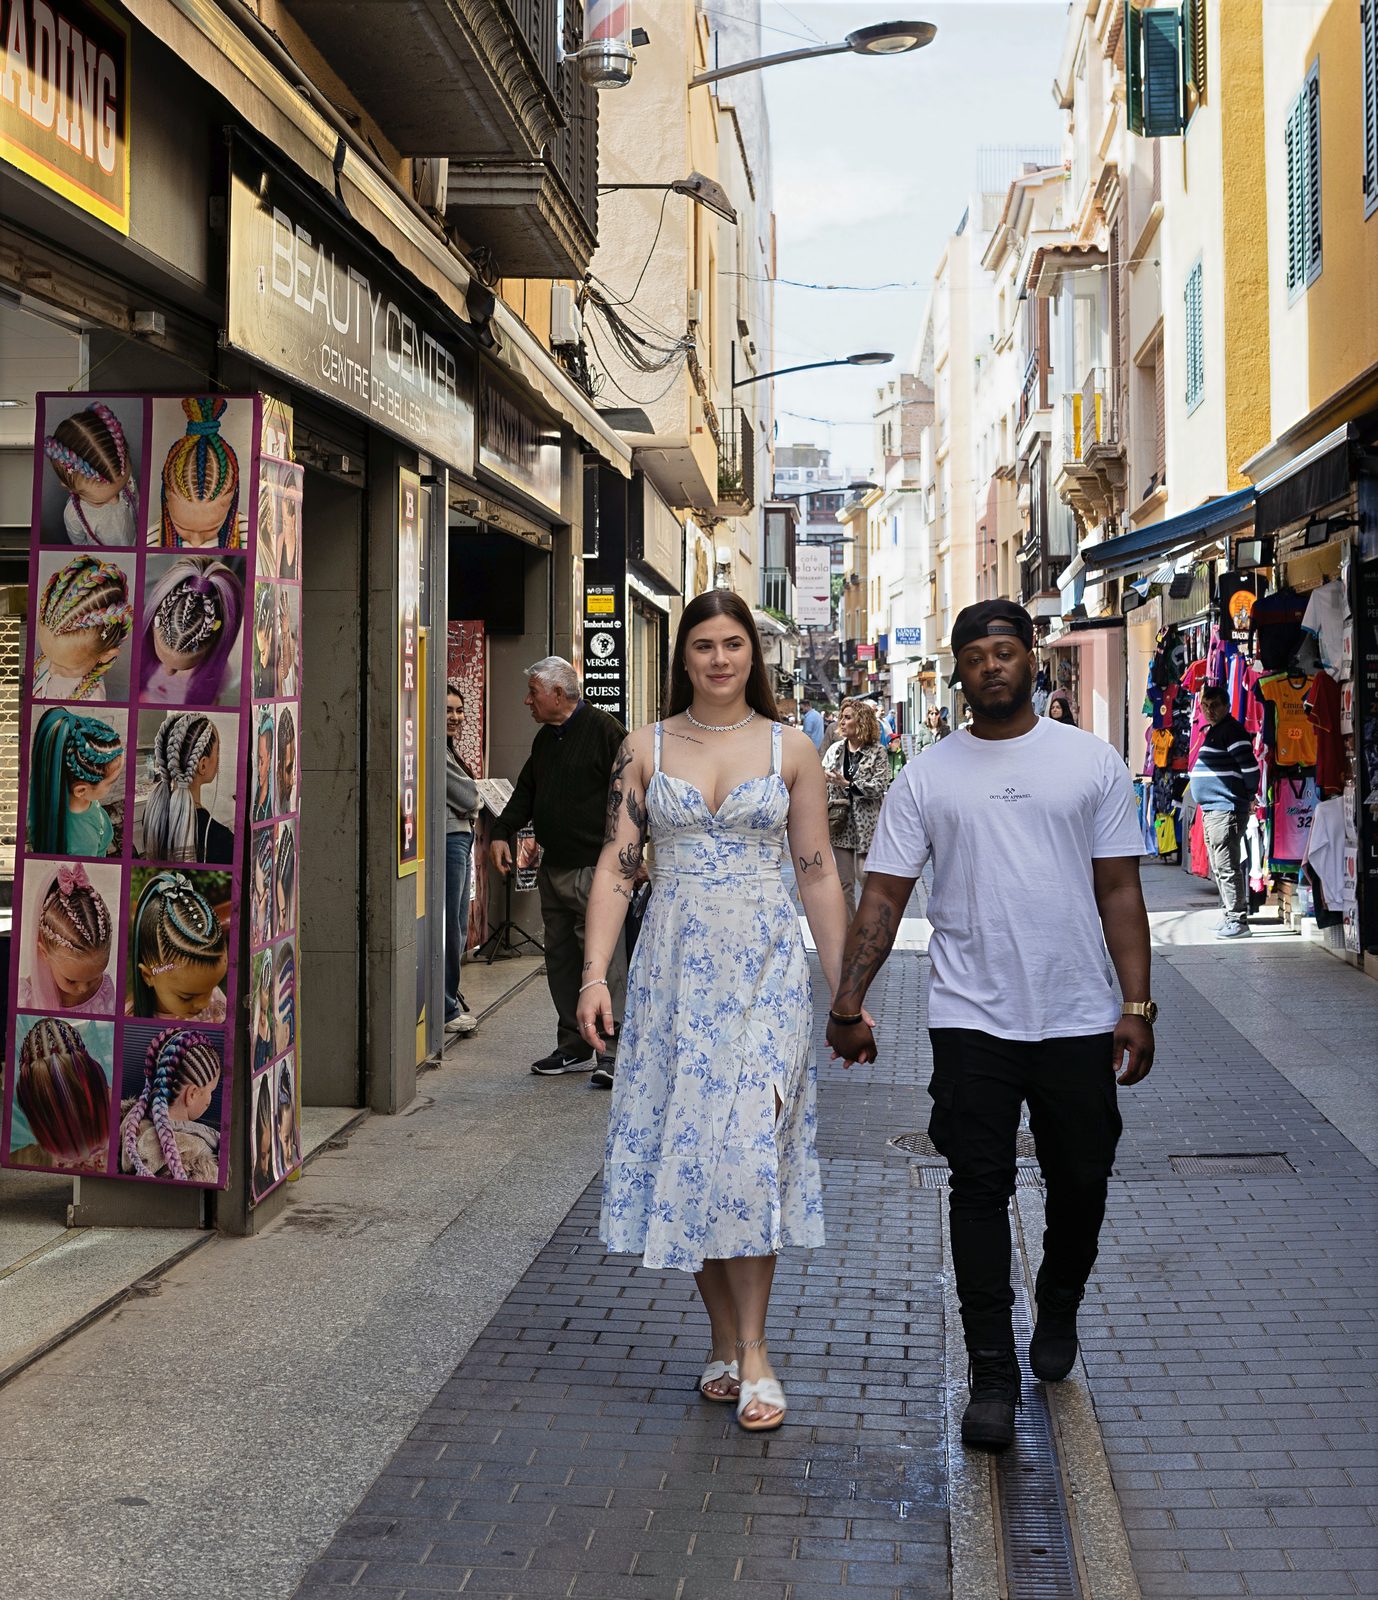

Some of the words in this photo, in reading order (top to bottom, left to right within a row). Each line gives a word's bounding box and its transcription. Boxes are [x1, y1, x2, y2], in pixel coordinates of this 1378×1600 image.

[0, 0, 116, 172] ADING
[272, 206, 382, 356] BEAUTY
[386, 301, 457, 415] CENTER
[321, 345, 369, 400] CENTRE
[371, 376, 385, 412] DE
[387, 387, 428, 437] BELLESA
[404, 490, 415, 689] BARBER
[584, 620, 613, 628] Timberland
[585, 686, 620, 696] GUESS
[586, 658, 619, 667] VERSACE
[404, 720, 414, 850] SHOP
[1297, 816, 1312, 828] 32
